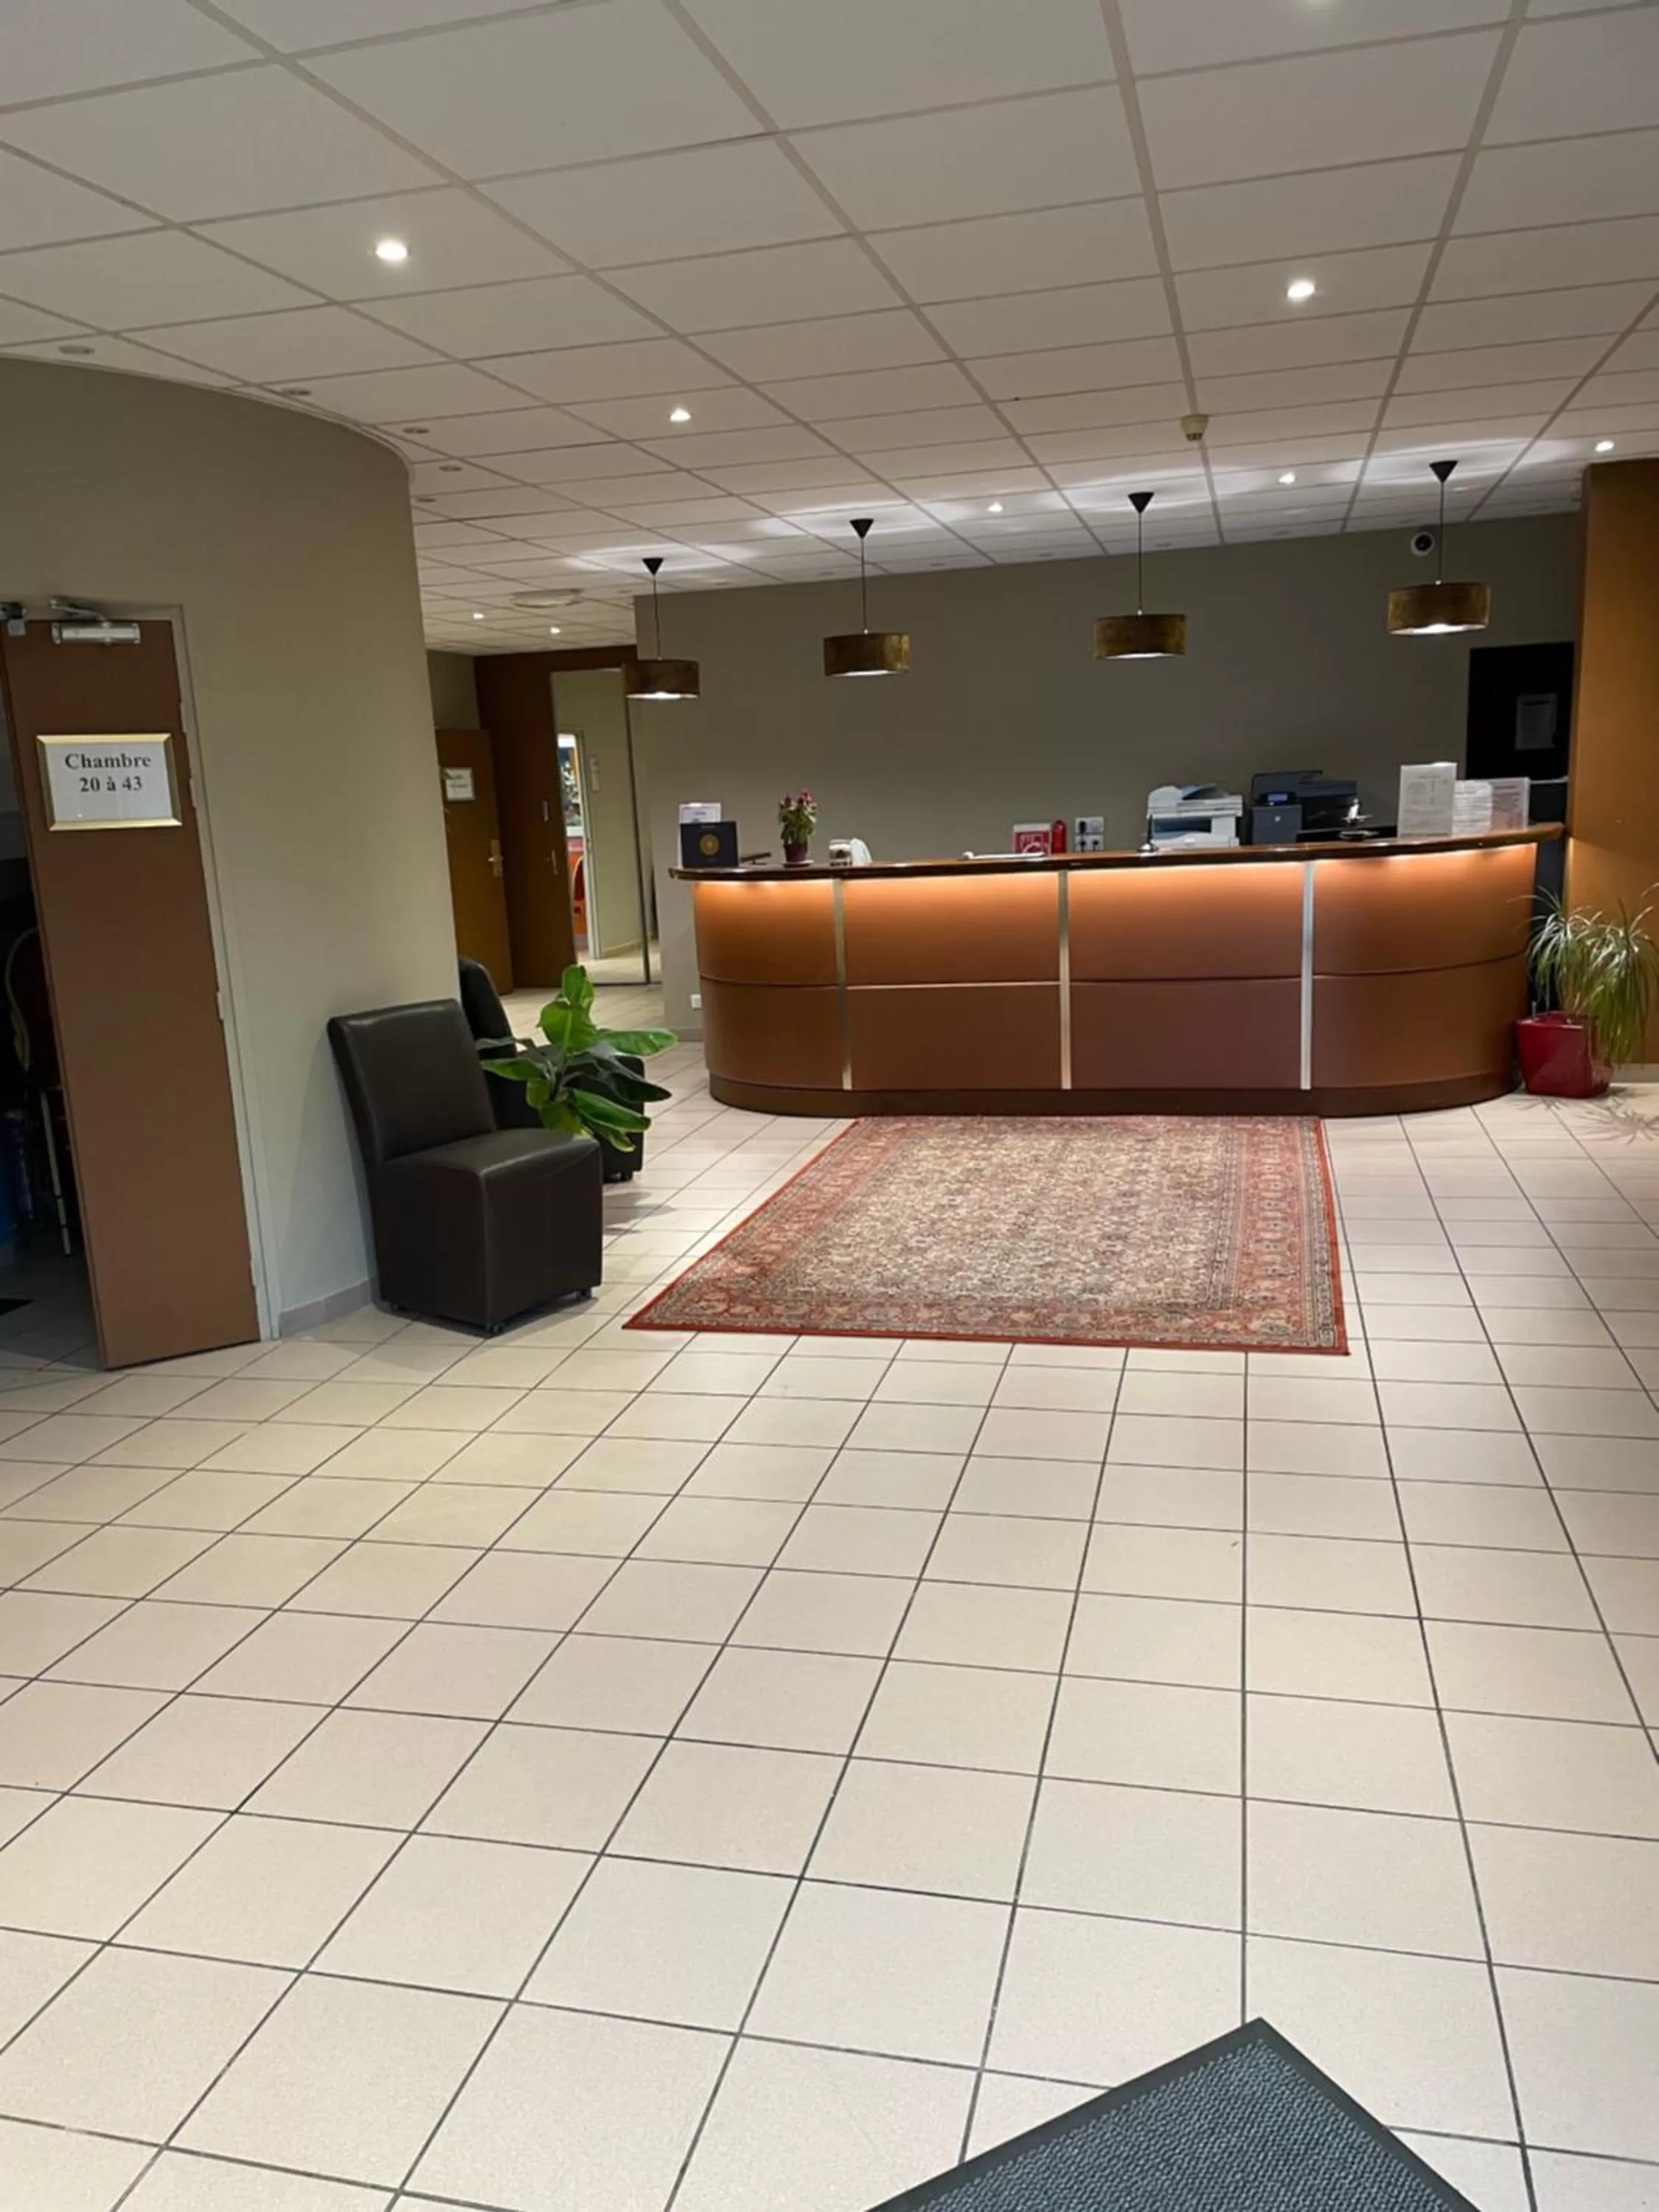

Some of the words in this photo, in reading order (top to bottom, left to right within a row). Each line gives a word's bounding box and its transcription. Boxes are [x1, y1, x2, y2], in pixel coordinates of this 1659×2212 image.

[65, 752, 151, 769] Chambre
[80, 776, 100, 792] 20
[106, 776, 116, 792] à
[122, 776, 142, 791] 43
